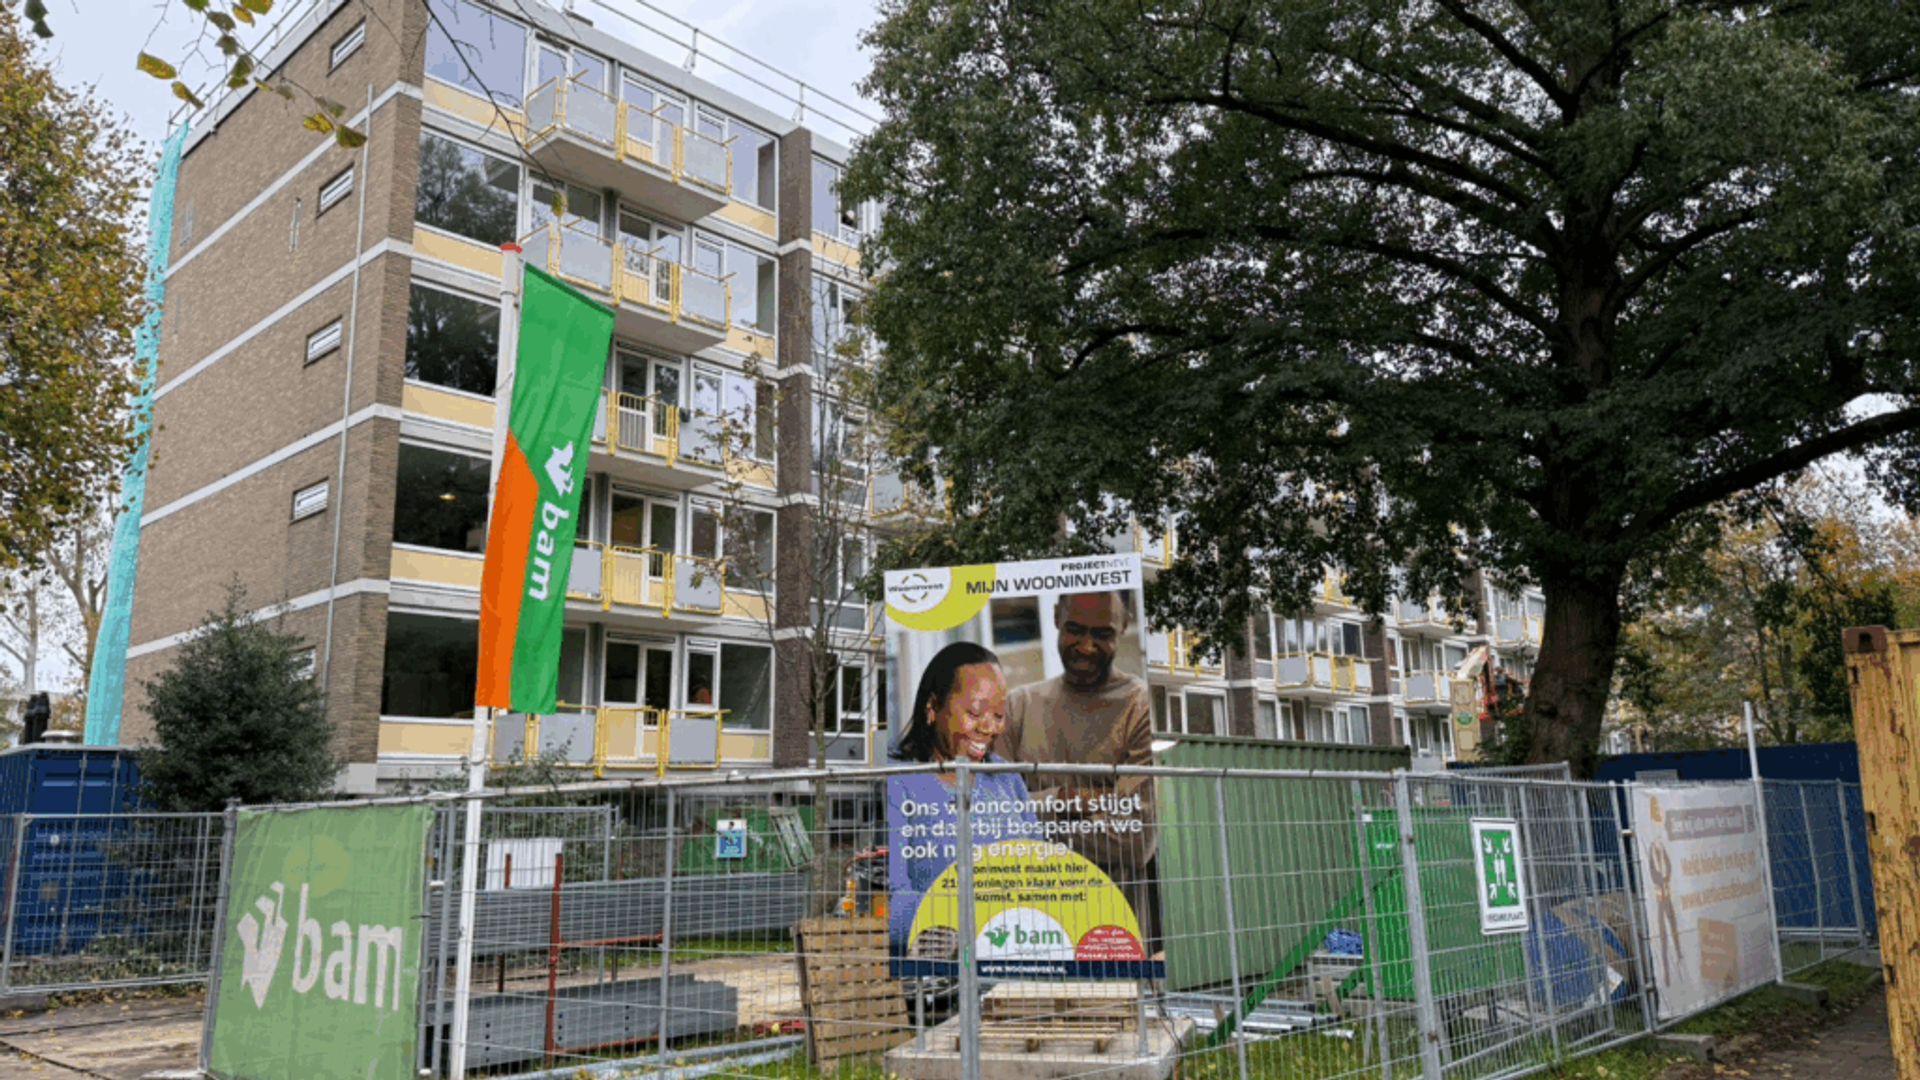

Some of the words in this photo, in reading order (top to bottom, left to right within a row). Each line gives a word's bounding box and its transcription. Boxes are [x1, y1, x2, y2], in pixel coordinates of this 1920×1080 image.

[528, 501, 571, 603] bam
[965, 578, 1009, 595] MIJN
[1013, 570, 1132, 592] WOONINVEST
[900, 799, 940, 817] Ons
[943, 794, 1083, 817] woncomfort
[1087, 792, 1142, 816] stijgt
[900, 823, 927, 838] en
[931, 816, 1001, 839] darbij
[1006, 817, 1106, 840] besparen
[1110, 818, 1143, 834] we
[900, 840, 939, 859] ook
[943, 842, 983, 862] ng
[988, 837, 1074, 861] energie!
[1014, 924, 1061, 944] bam
[292, 882, 404, 1012] bam
